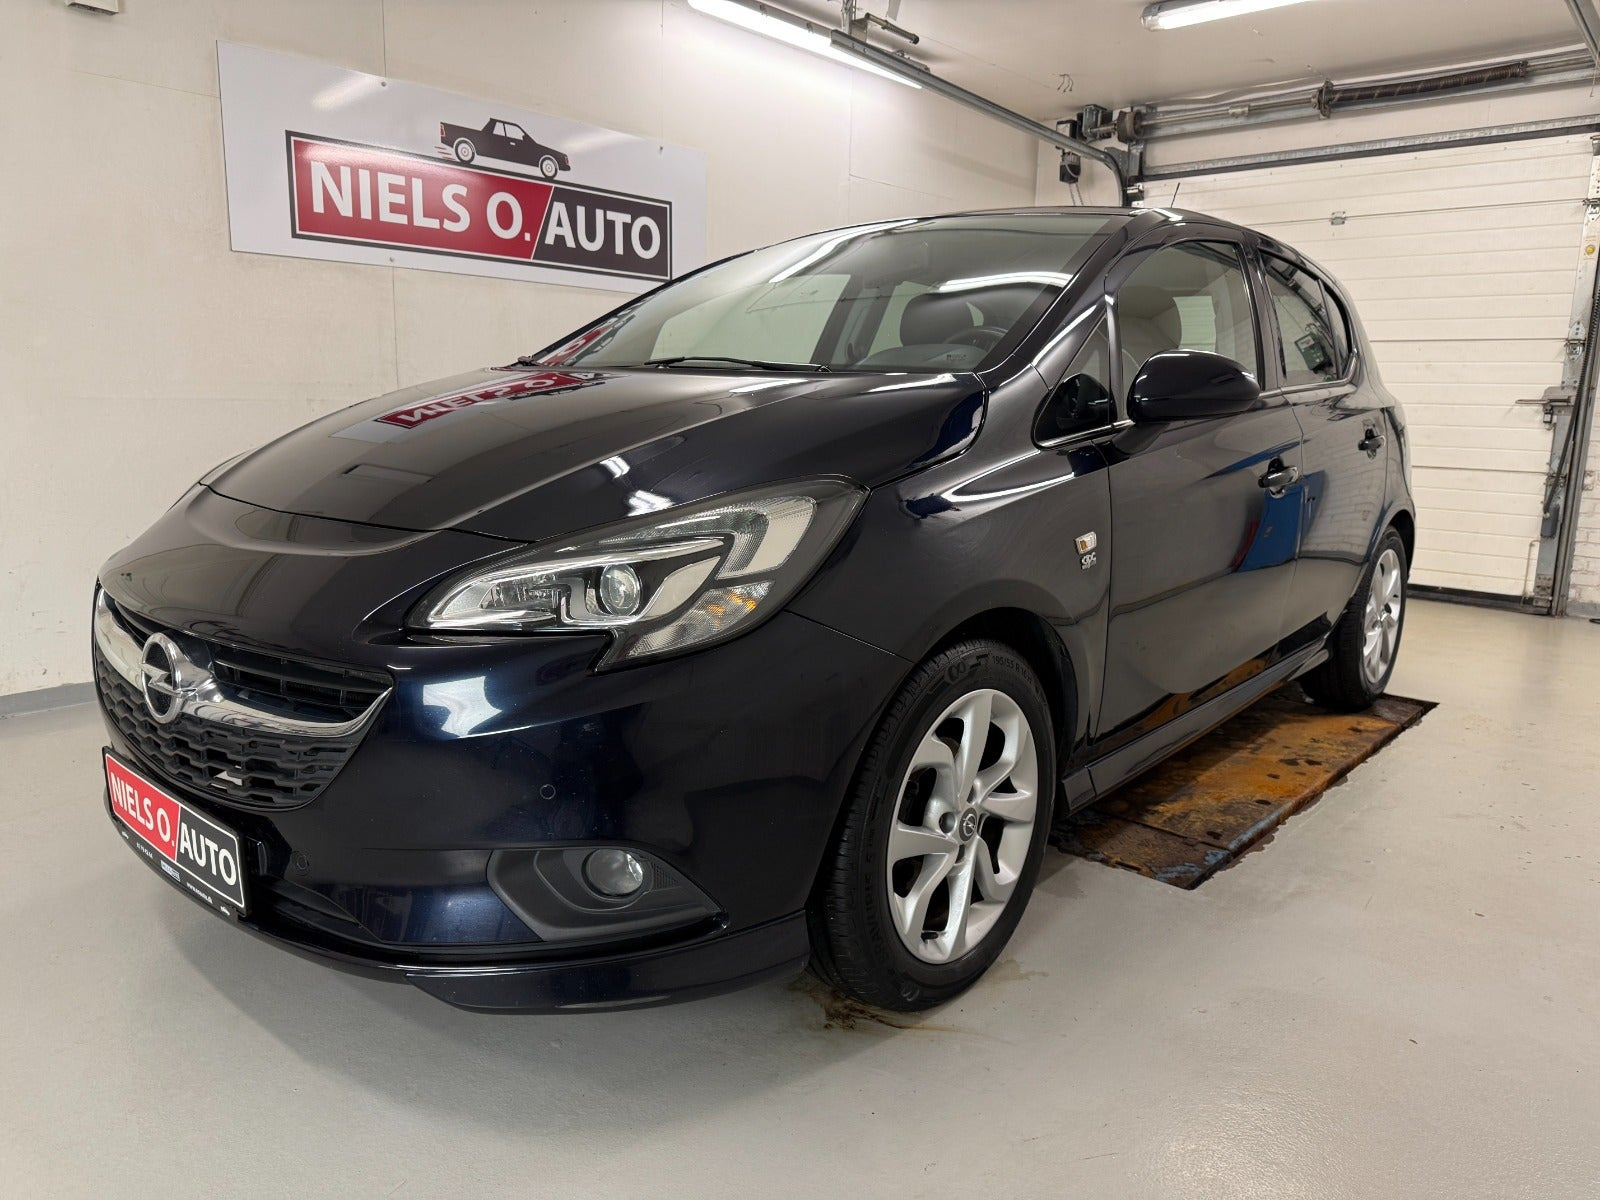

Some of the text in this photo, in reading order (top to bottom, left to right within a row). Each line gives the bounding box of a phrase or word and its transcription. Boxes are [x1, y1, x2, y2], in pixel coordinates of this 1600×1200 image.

[310, 161, 661, 259] NIELS O. AUTO
[112, 772, 236, 886] NIELS O. AUTO
